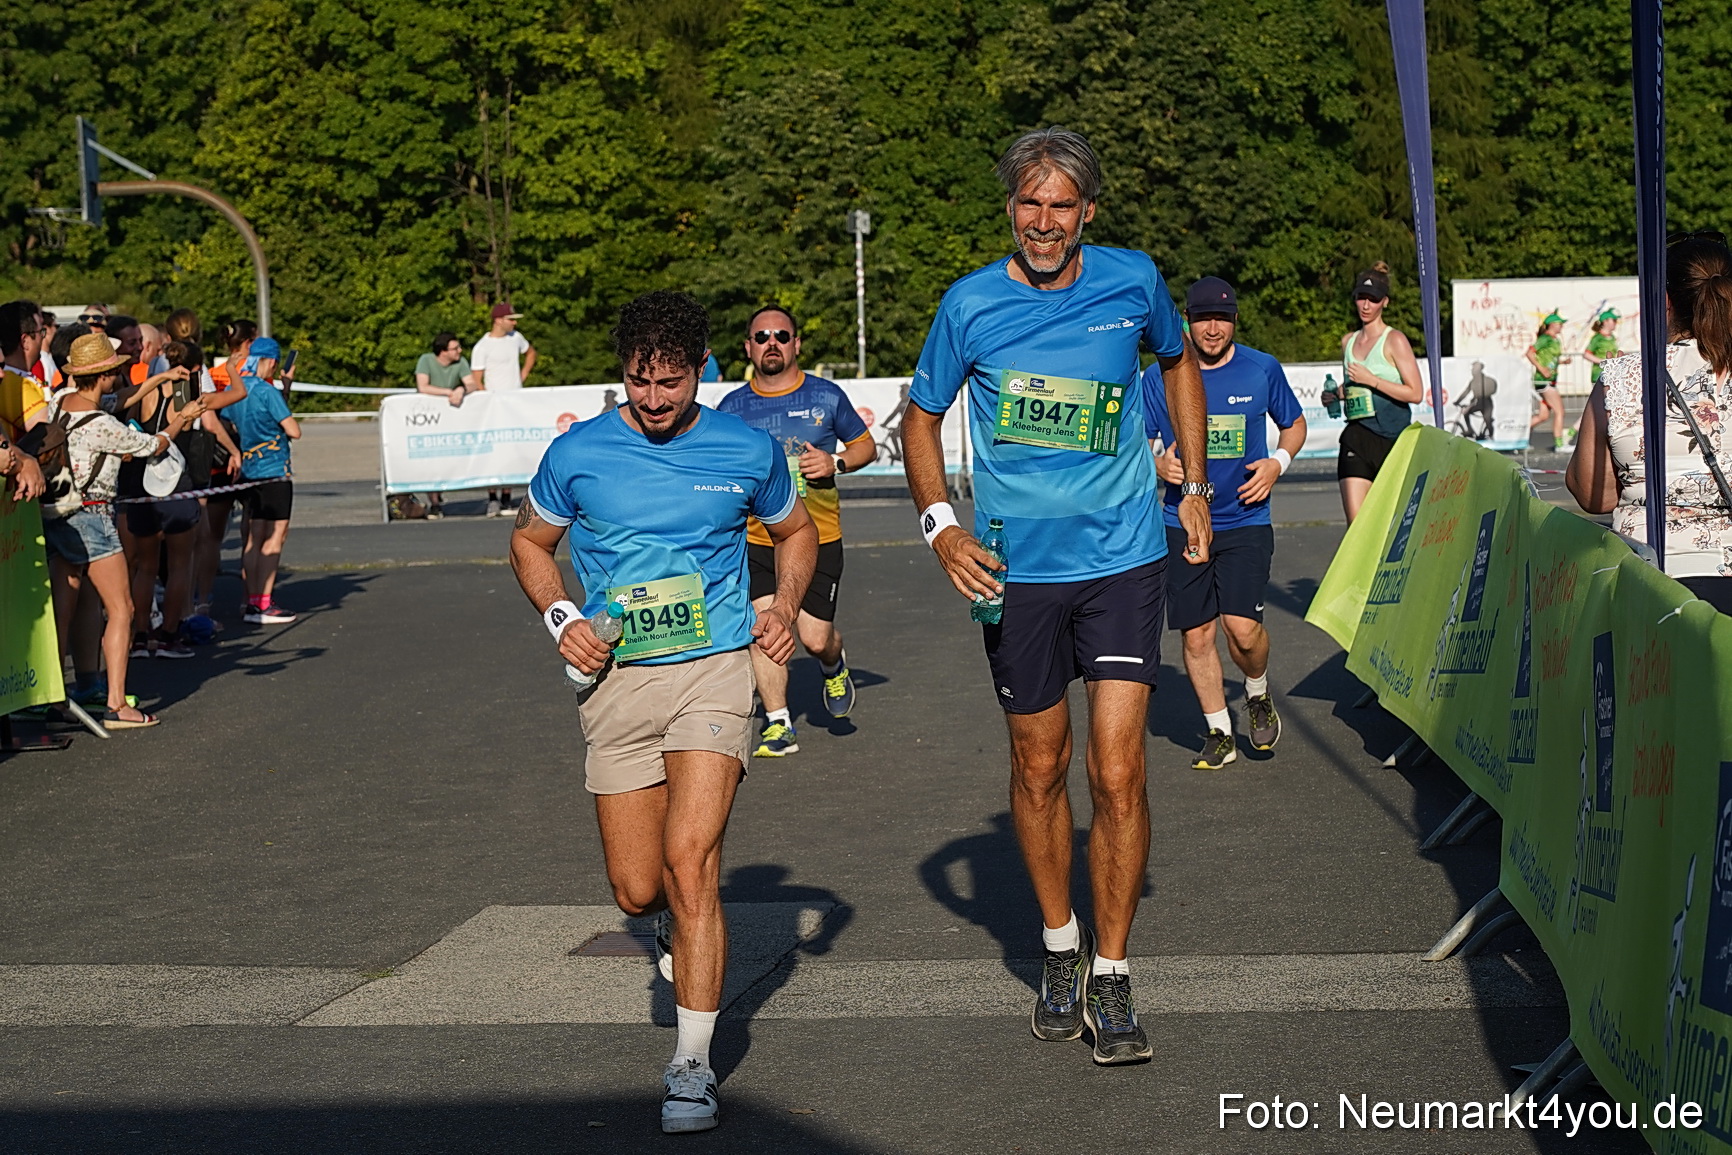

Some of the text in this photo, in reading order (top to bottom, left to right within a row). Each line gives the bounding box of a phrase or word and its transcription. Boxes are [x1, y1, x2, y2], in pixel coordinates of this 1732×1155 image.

[1088, 322, 1122, 333] RAILONE
[406, 412, 441, 426] NOW
[1001, 401, 1012, 427] RUN
[1014, 396, 1080, 426] 1947
[1012, 420, 1076, 437] Kleeberg Jens
[1078, 408, 1091, 442] 2022
[465, 434, 475, 446] &
[1208, 430, 1231, 444] 34
[693, 484, 731, 493] RAILONE
[630, 593, 659, 605] Firmenlauf
[624, 602, 690, 635] 1949
[692, 602, 706, 637] 2022
[625, 634, 649, 645] Sheikh
[649, 632, 668, 642] Nour
[669, 627, 696, 638] Ammar
